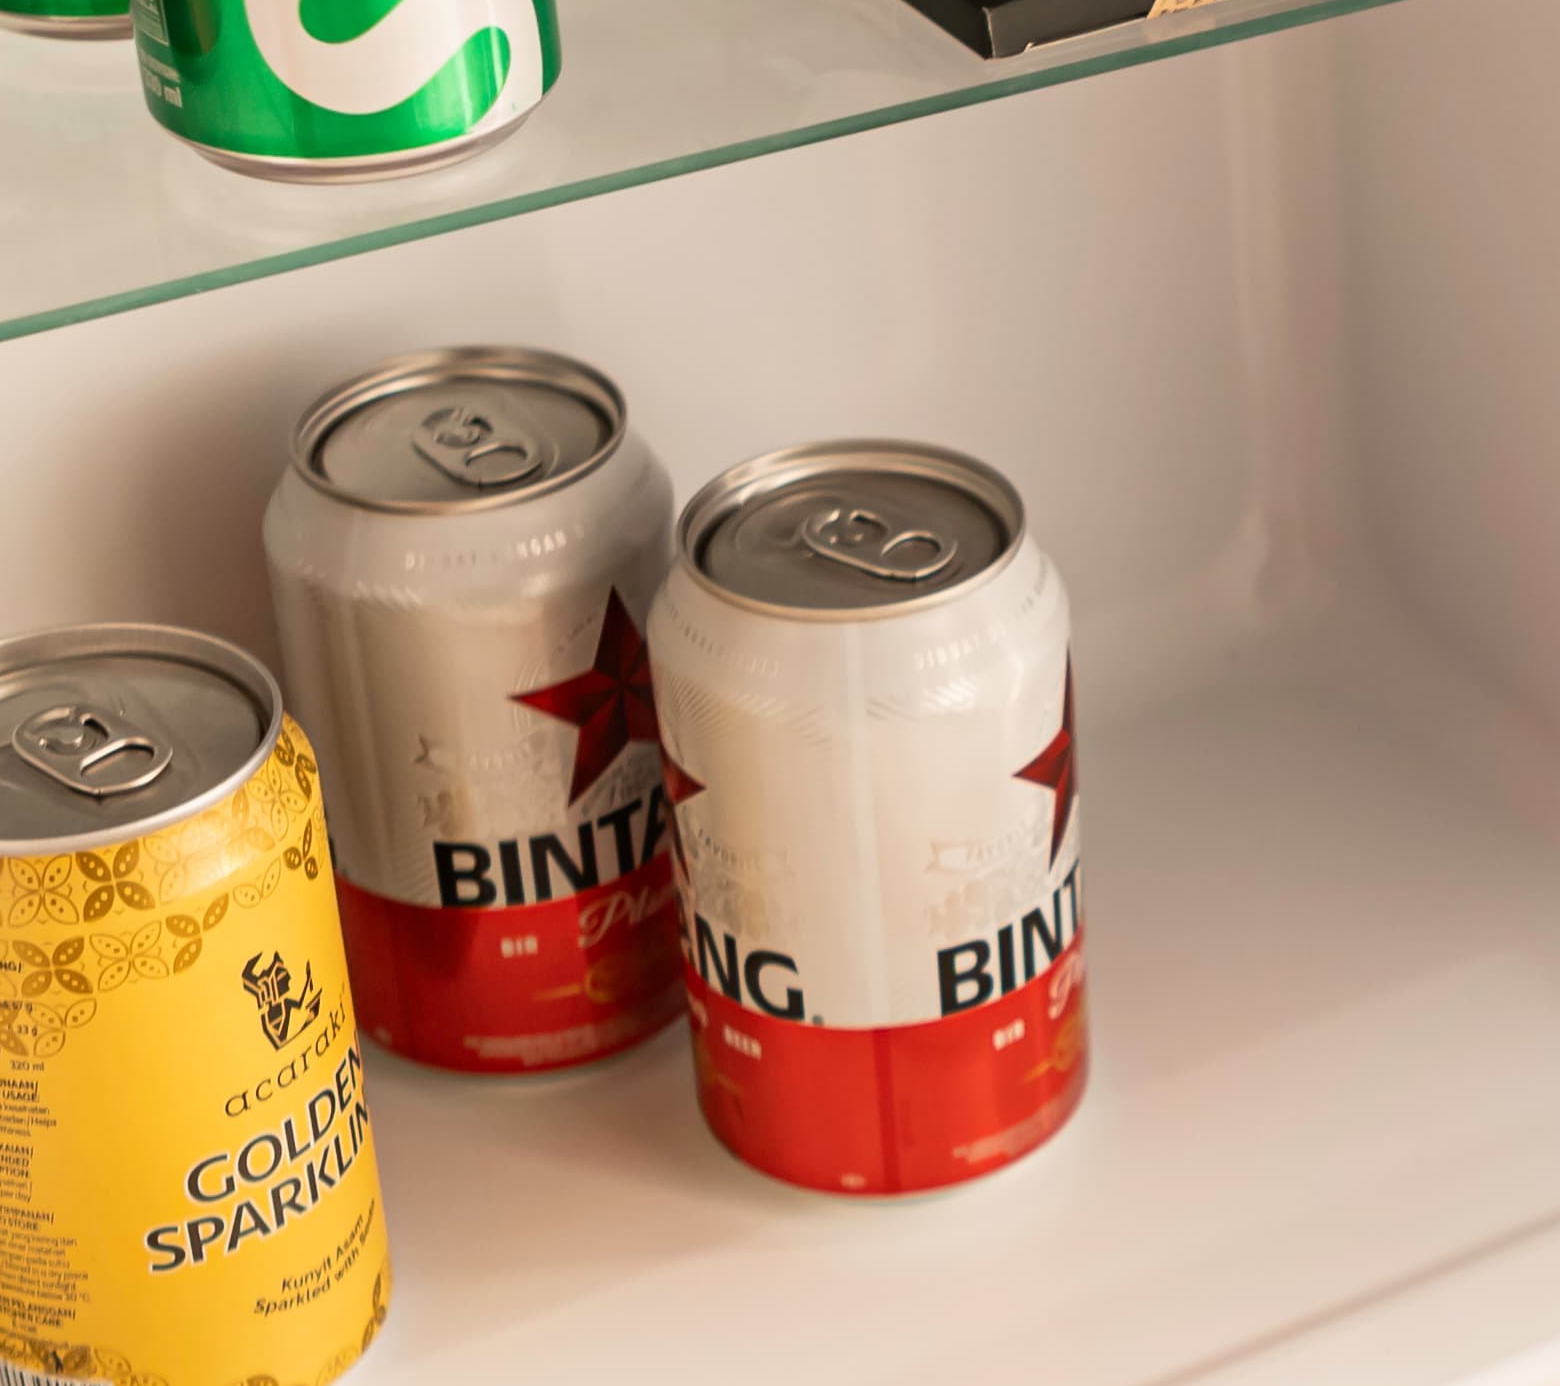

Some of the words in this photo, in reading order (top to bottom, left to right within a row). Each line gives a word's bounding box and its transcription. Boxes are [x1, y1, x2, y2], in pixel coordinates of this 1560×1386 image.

[32, 1062, 45, 1071] ml
[254, 1276, 332, 1317] Sparkled
[333, 1249, 360, 1283] with
[280, 1256, 332, 1294] Kunyit
[334, 1213, 365, 1261] Asam
